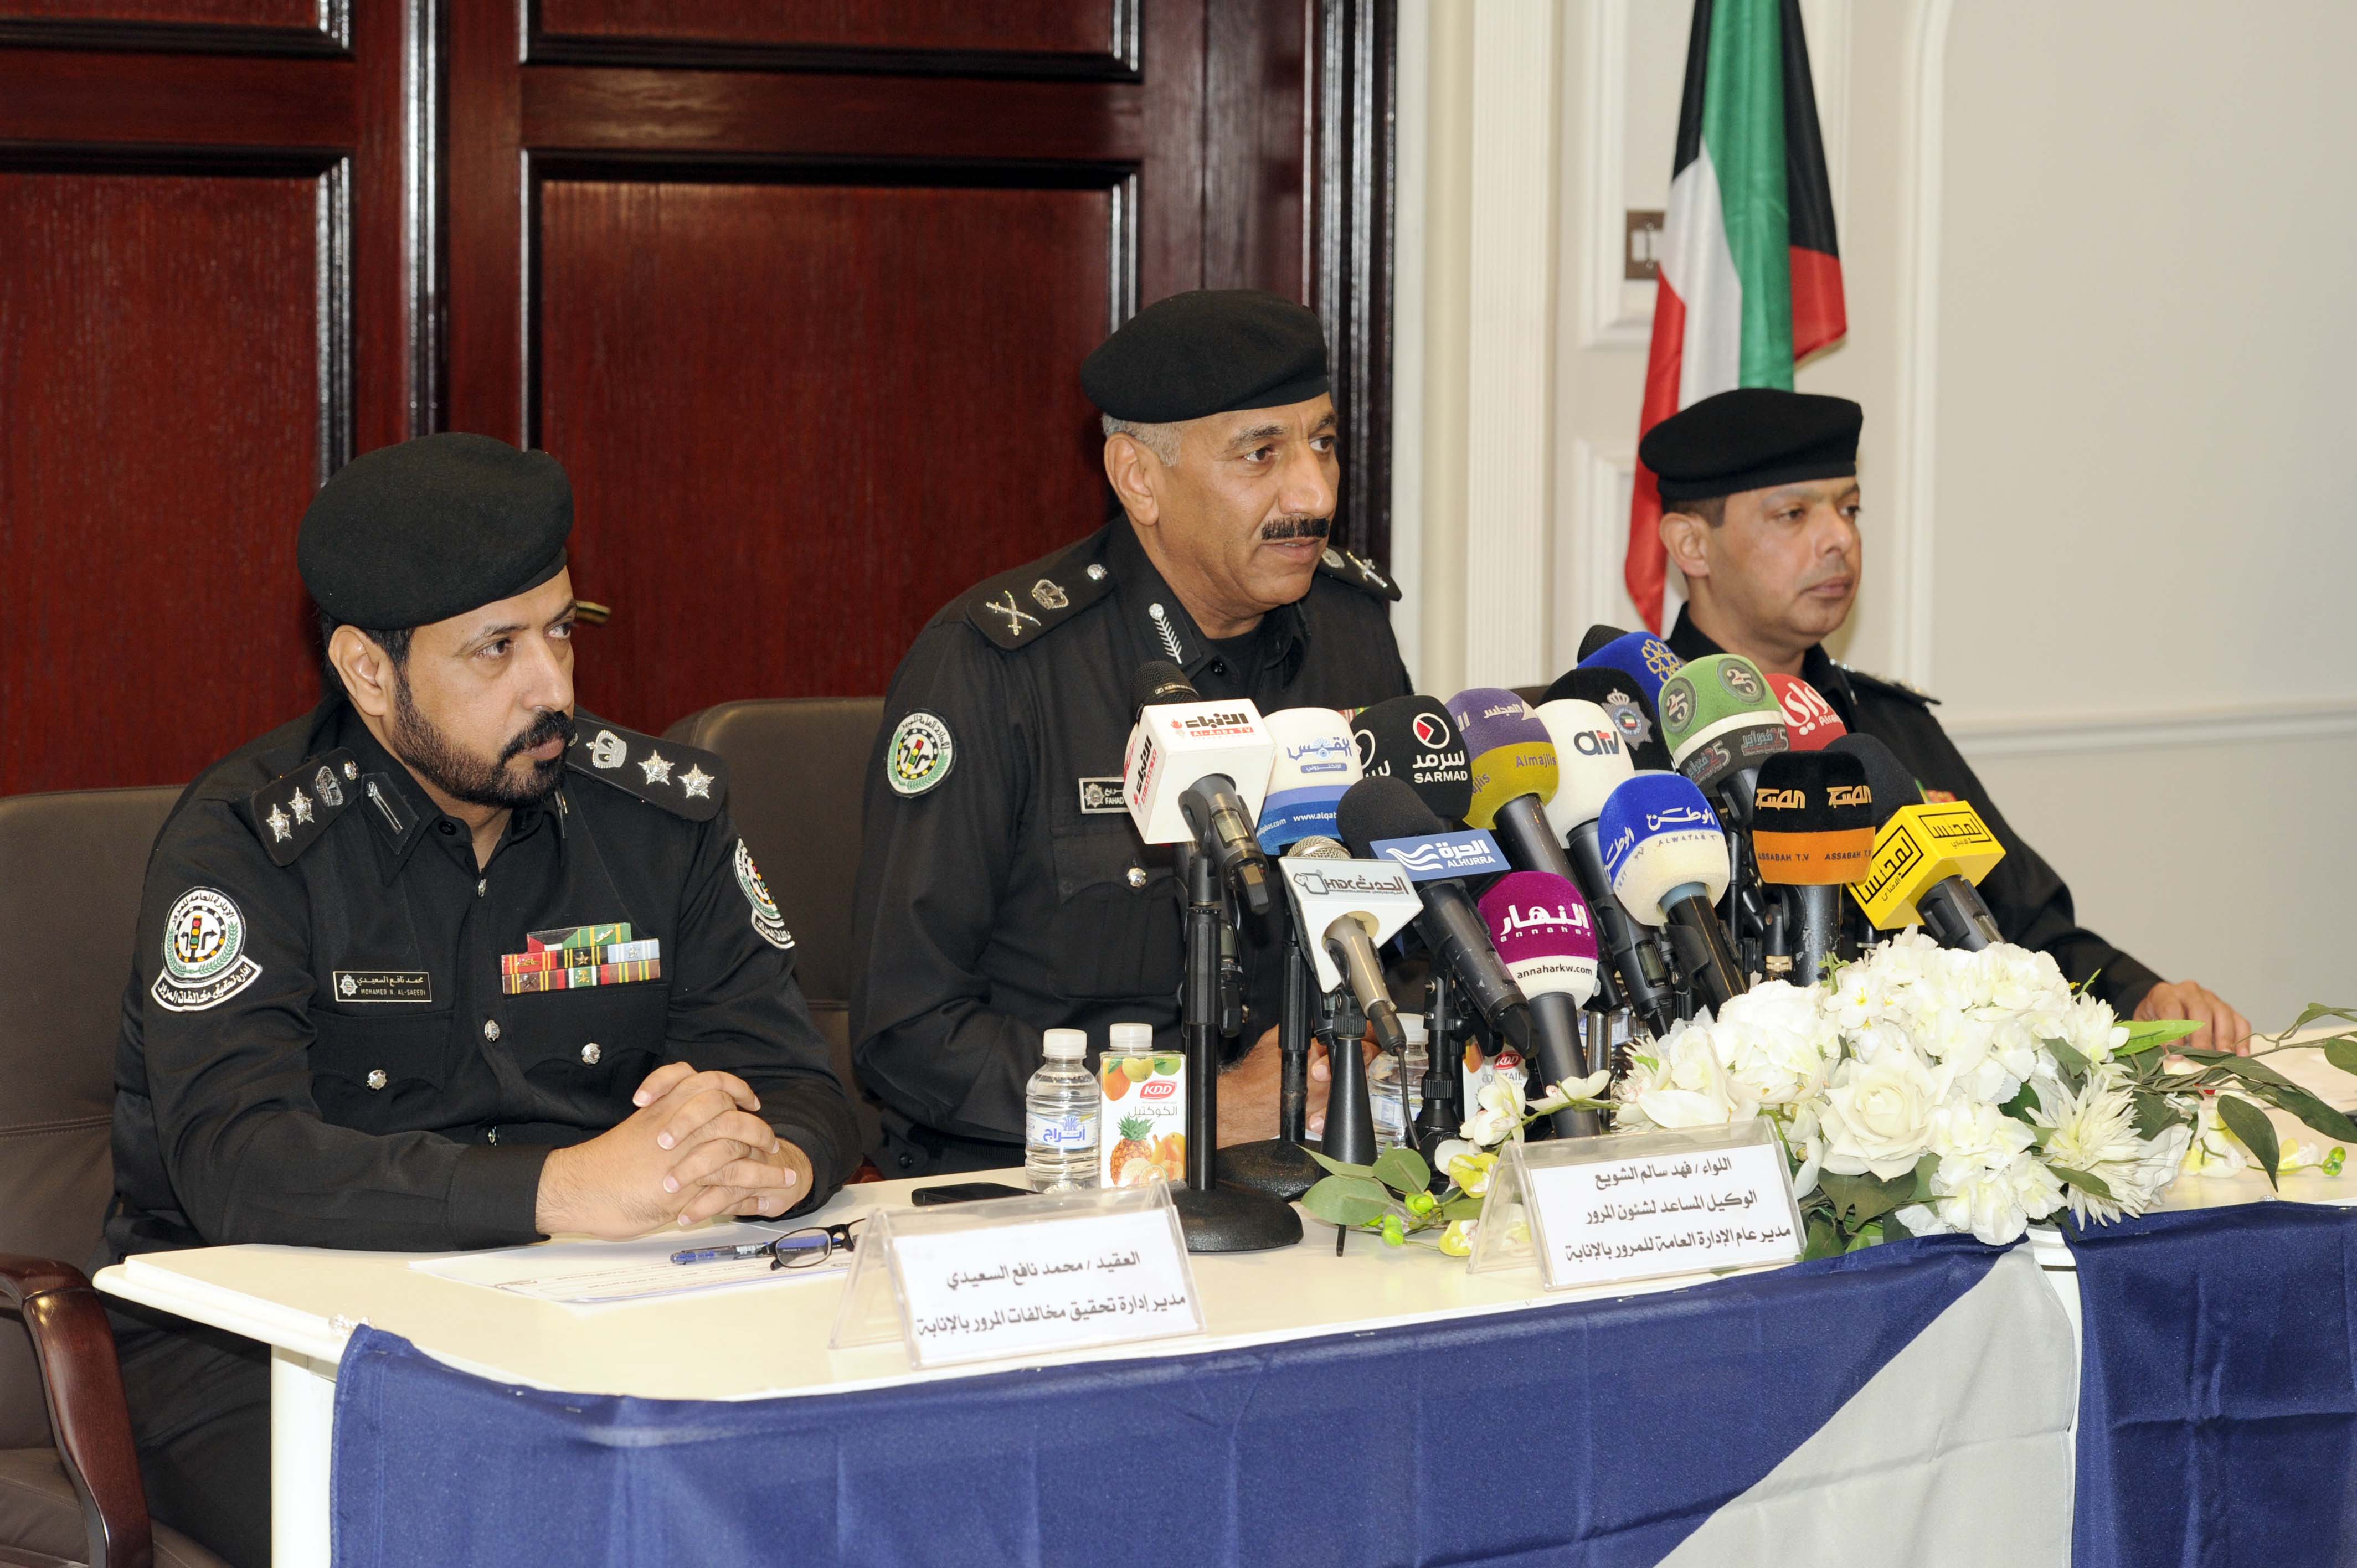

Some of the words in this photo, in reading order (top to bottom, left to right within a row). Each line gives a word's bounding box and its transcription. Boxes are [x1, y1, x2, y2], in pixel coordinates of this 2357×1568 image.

[1726, 669, 1757, 693] 25
[1666, 692, 1689, 720] 25
[1412, 750, 1466, 770] سرمد
[1516, 754, 1557, 768] Almajlis
[1414, 771, 1468, 784] SARMAD
[1646, 806, 1715, 831] الوطن
[1435, 839, 1490, 859] الحرة
[1758, 852, 1792, 861] ASSABAH
[1825, 851, 1861, 860] ASSABAH
[1447, 855, 1496, 868] ALHURRA
[1500, 903, 1589, 936] النهار
[1500, 926, 1591, 942] annahar
[357, 975, 389, 986] السعيدي
[389, 975, 405, 987] نافع
[1517, 963, 1593, 979] annaharkw.com
[1482, 1072, 1522, 1084] COTAIL
[1144, 1085, 1173, 1095] KDD
[1594, 1165, 1638, 1190] الشويع
[1641, 1163, 1667, 1184] سالم
[1671, 1160, 1692, 1179] فهد
[1617, 1198, 1657, 1221] لشئون
[1660, 1194, 1705, 1214] المساعد
[1707, 1189, 1758, 1212] الوكيل
[1586, 1203, 1615, 1225] المرور
[1655, 1232, 1696, 1252] العامة
[1736, 1226, 1757, 1247] عام
[1759, 1225, 1792, 1244] مدير
[1615, 1236, 1654, 1259] للمرور
[946, 1264, 1010, 1291] السعيدي
[1012, 1262, 1038, 1286] نافع
[1042, 1261, 1083, 1275] محمد
[1070, 1298, 1116, 1321] تحقيق
[1152, 1293, 1186, 1313] مدير
[974, 1309, 1006, 1333] المرور
[1008, 1306, 1066, 1324] مخالفات
